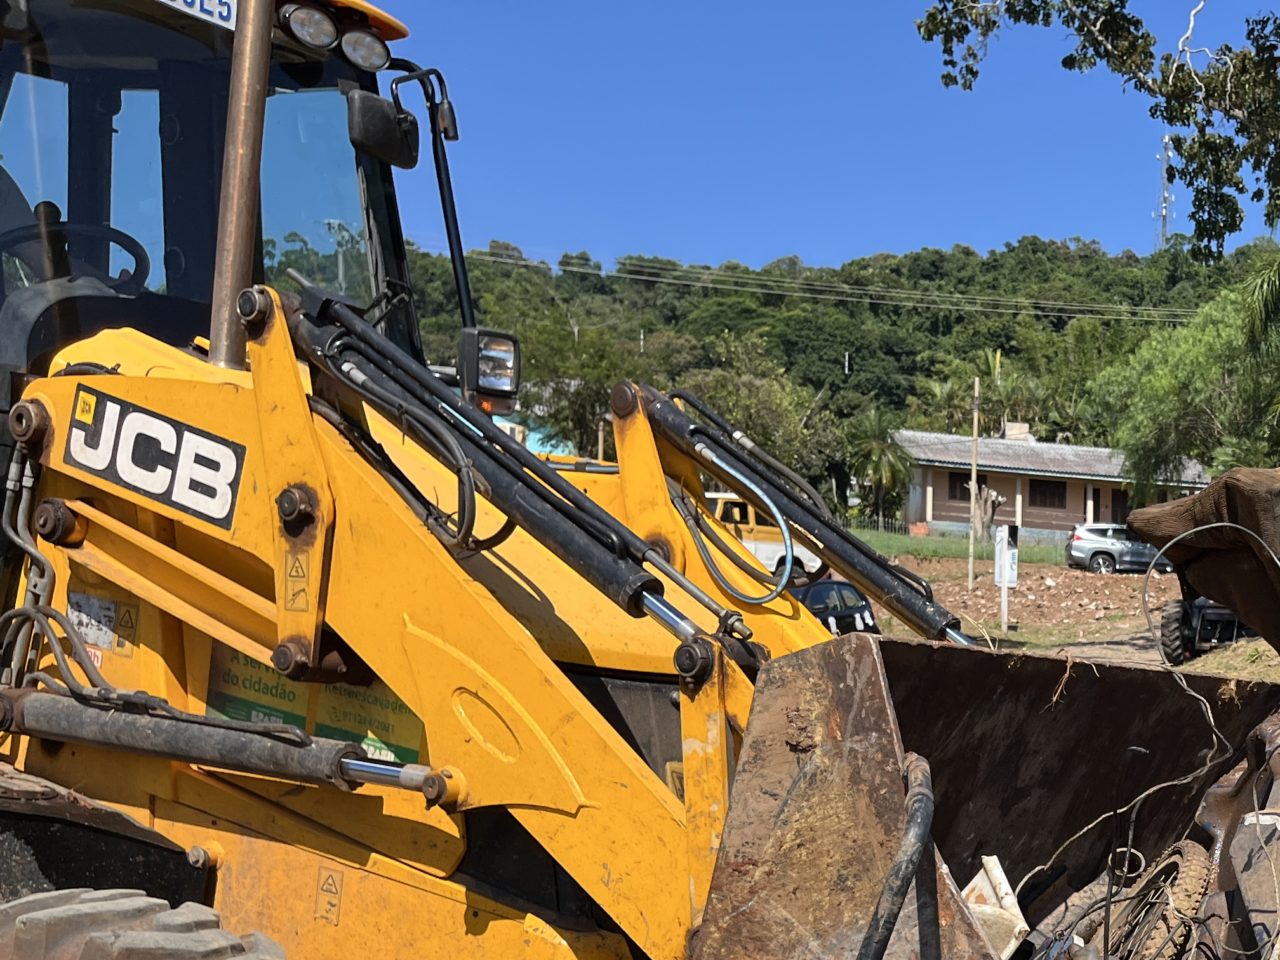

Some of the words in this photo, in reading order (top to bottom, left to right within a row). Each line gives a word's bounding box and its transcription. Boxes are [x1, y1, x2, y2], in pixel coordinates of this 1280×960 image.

[69, 400, 237, 520] JCB
[222, 668, 240, 687] do
[241, 675, 297, 703] cidadão
